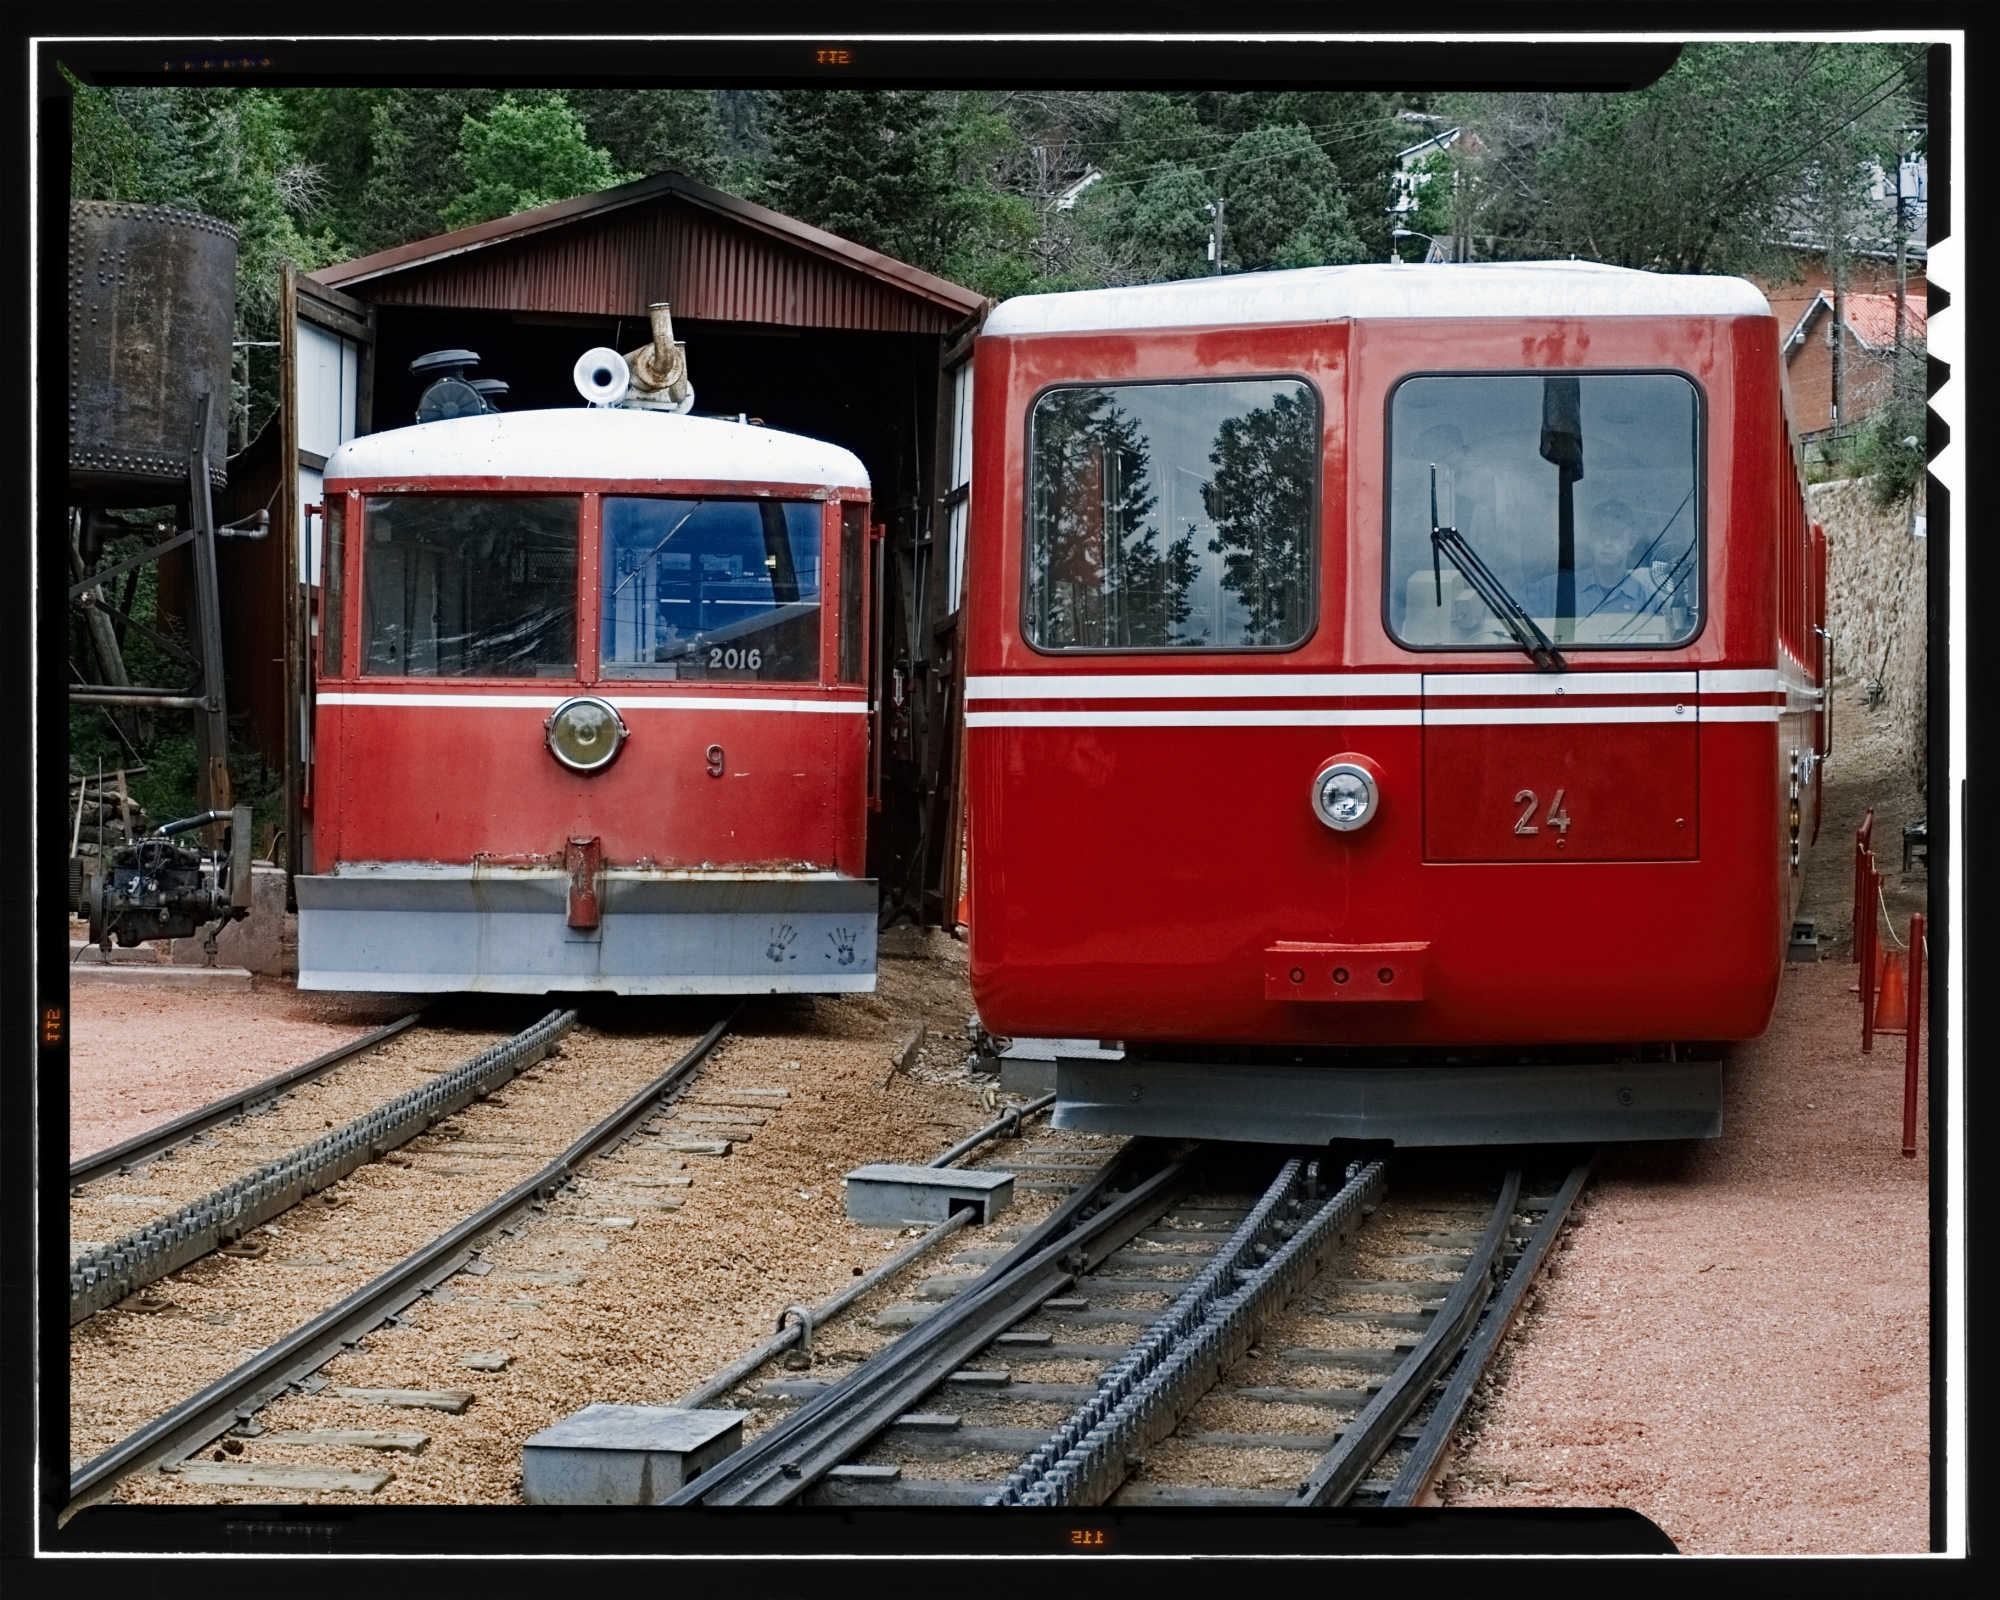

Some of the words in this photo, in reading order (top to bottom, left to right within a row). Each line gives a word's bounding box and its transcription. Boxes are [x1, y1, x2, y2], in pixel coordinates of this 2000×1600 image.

[709, 648, 762, 670] 2016
[706, 744, 725, 777] 9
[1514, 789, 1571, 834] 24
